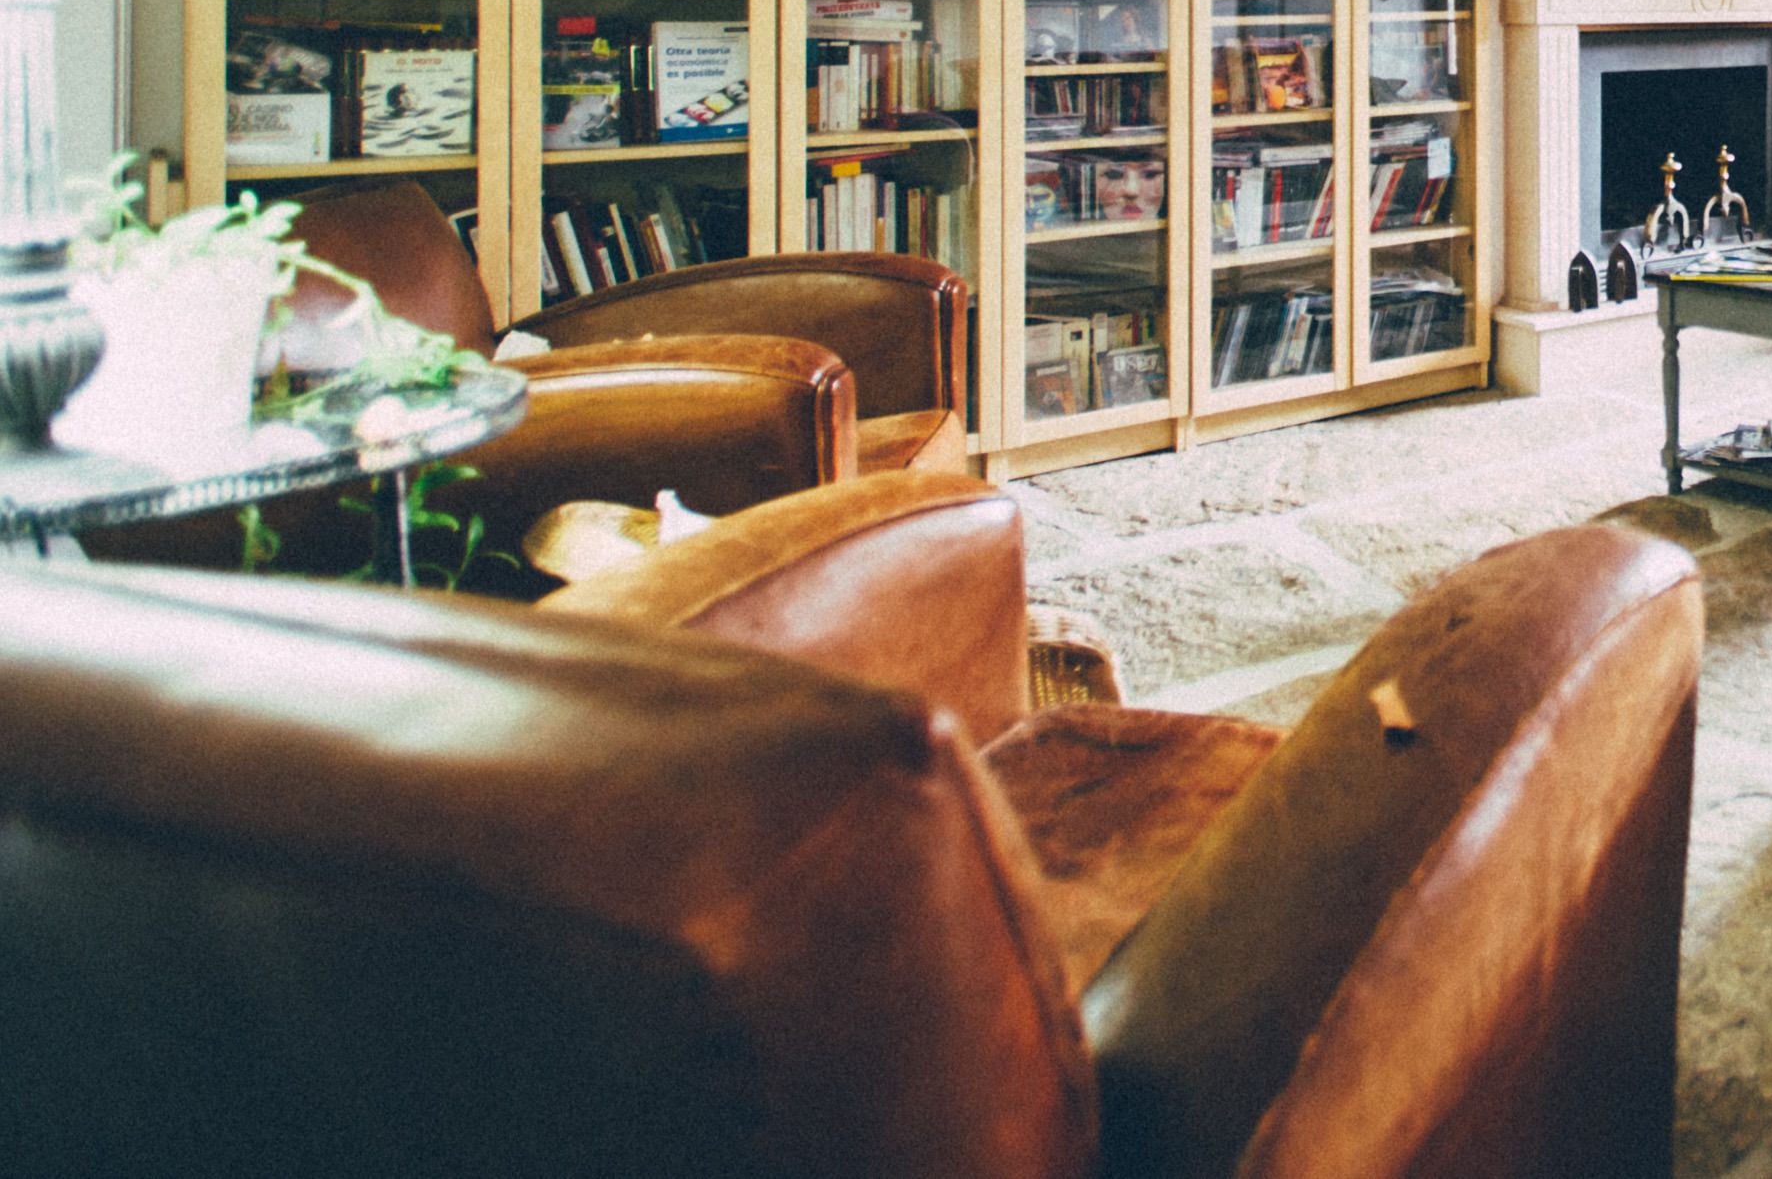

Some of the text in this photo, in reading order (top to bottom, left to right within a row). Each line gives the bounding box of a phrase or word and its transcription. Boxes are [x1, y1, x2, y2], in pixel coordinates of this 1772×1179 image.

[665, 45, 731, 56] Otra teoría
[666, 68, 726, 80] es posible
